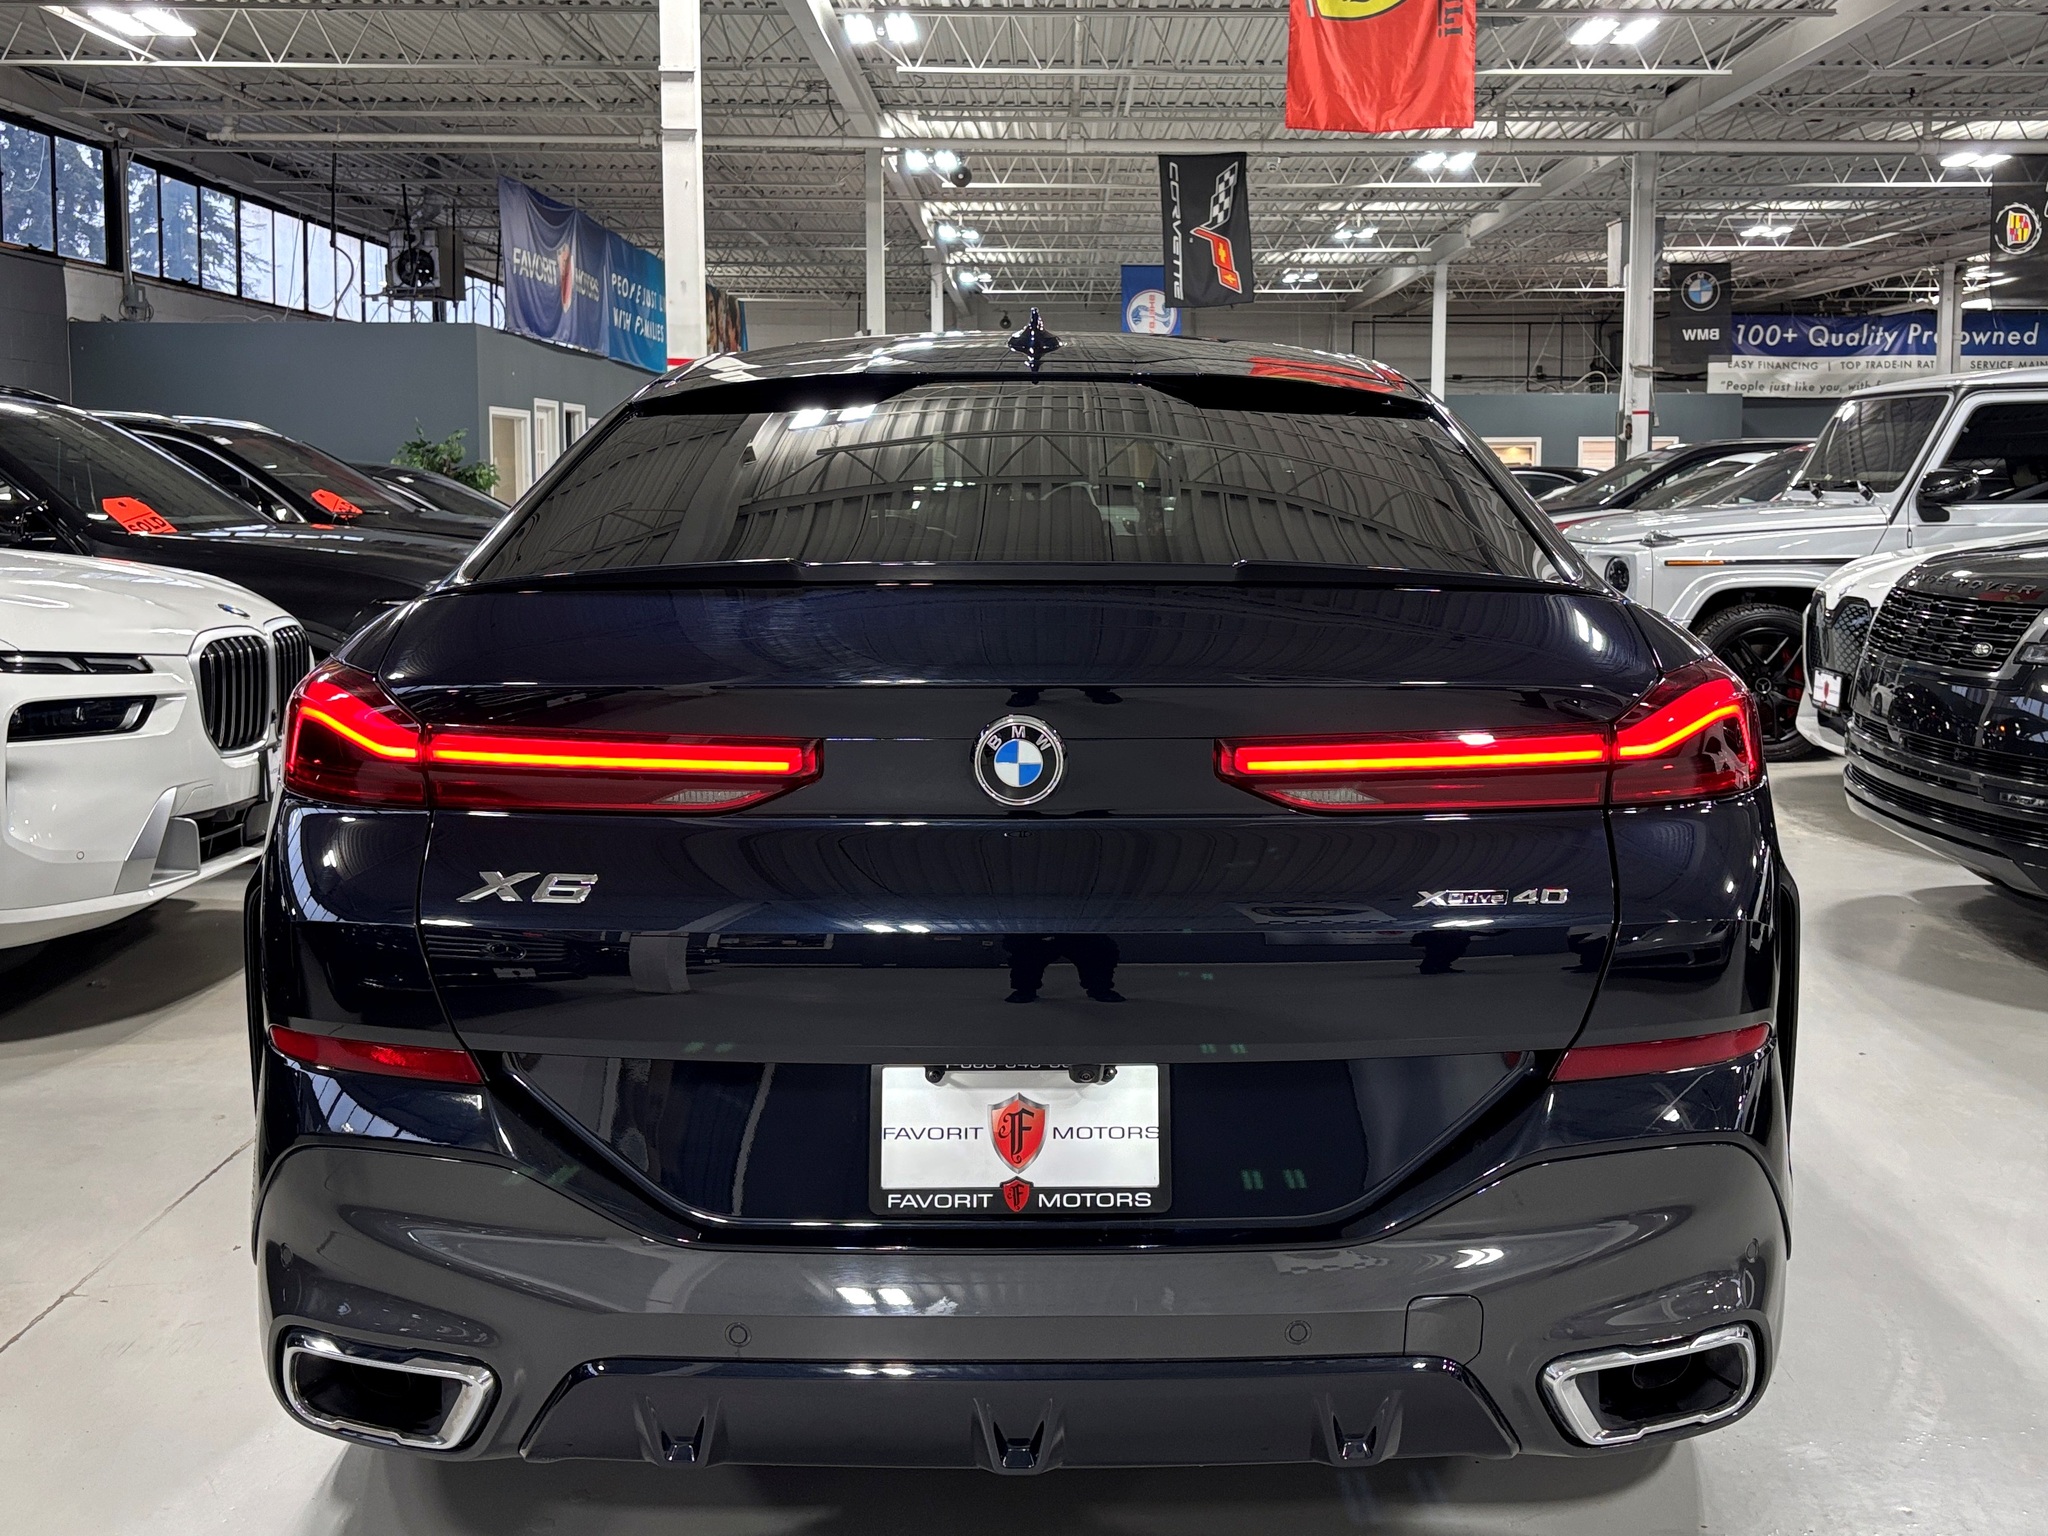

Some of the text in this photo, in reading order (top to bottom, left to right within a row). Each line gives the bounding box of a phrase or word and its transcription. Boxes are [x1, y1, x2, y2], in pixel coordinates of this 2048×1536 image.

[1169, 162, 1184, 300] CORVETTE
[513, 248, 557, 286] FAVORIT
[613, 306, 665, 344] WITH FAMILIES
[1737, 323, 1798, 346] 100+
[1808, 323, 1899, 352] Quality
[1727, 360, 1754, 370] EASY
[1758, 360, 1819, 370] FINANCING
[1840, 361, 1862, 370] TOP
[1865, 360, 1912, 370] TRADE-IN
[1970, 360, 2014, 370] SERVICE
[1769, 381, 1791, 393] just
[1794, 380, 1816, 392] like
[127, 516, 168, 532] SOLD
[1955, 579, 2038, 595] ROVER
[986, 725, 1052, 751] BMW
[456, 870, 599, 904] X6
[1512, 888, 1569, 905] 40
[883, 1126, 984, 1140] FAVORIT
[1052, 1125, 1160, 1140] MOTORS
[887, 1193, 994, 1209] FAVORIT
[1038, 1191, 1152, 1208] MOTORS
